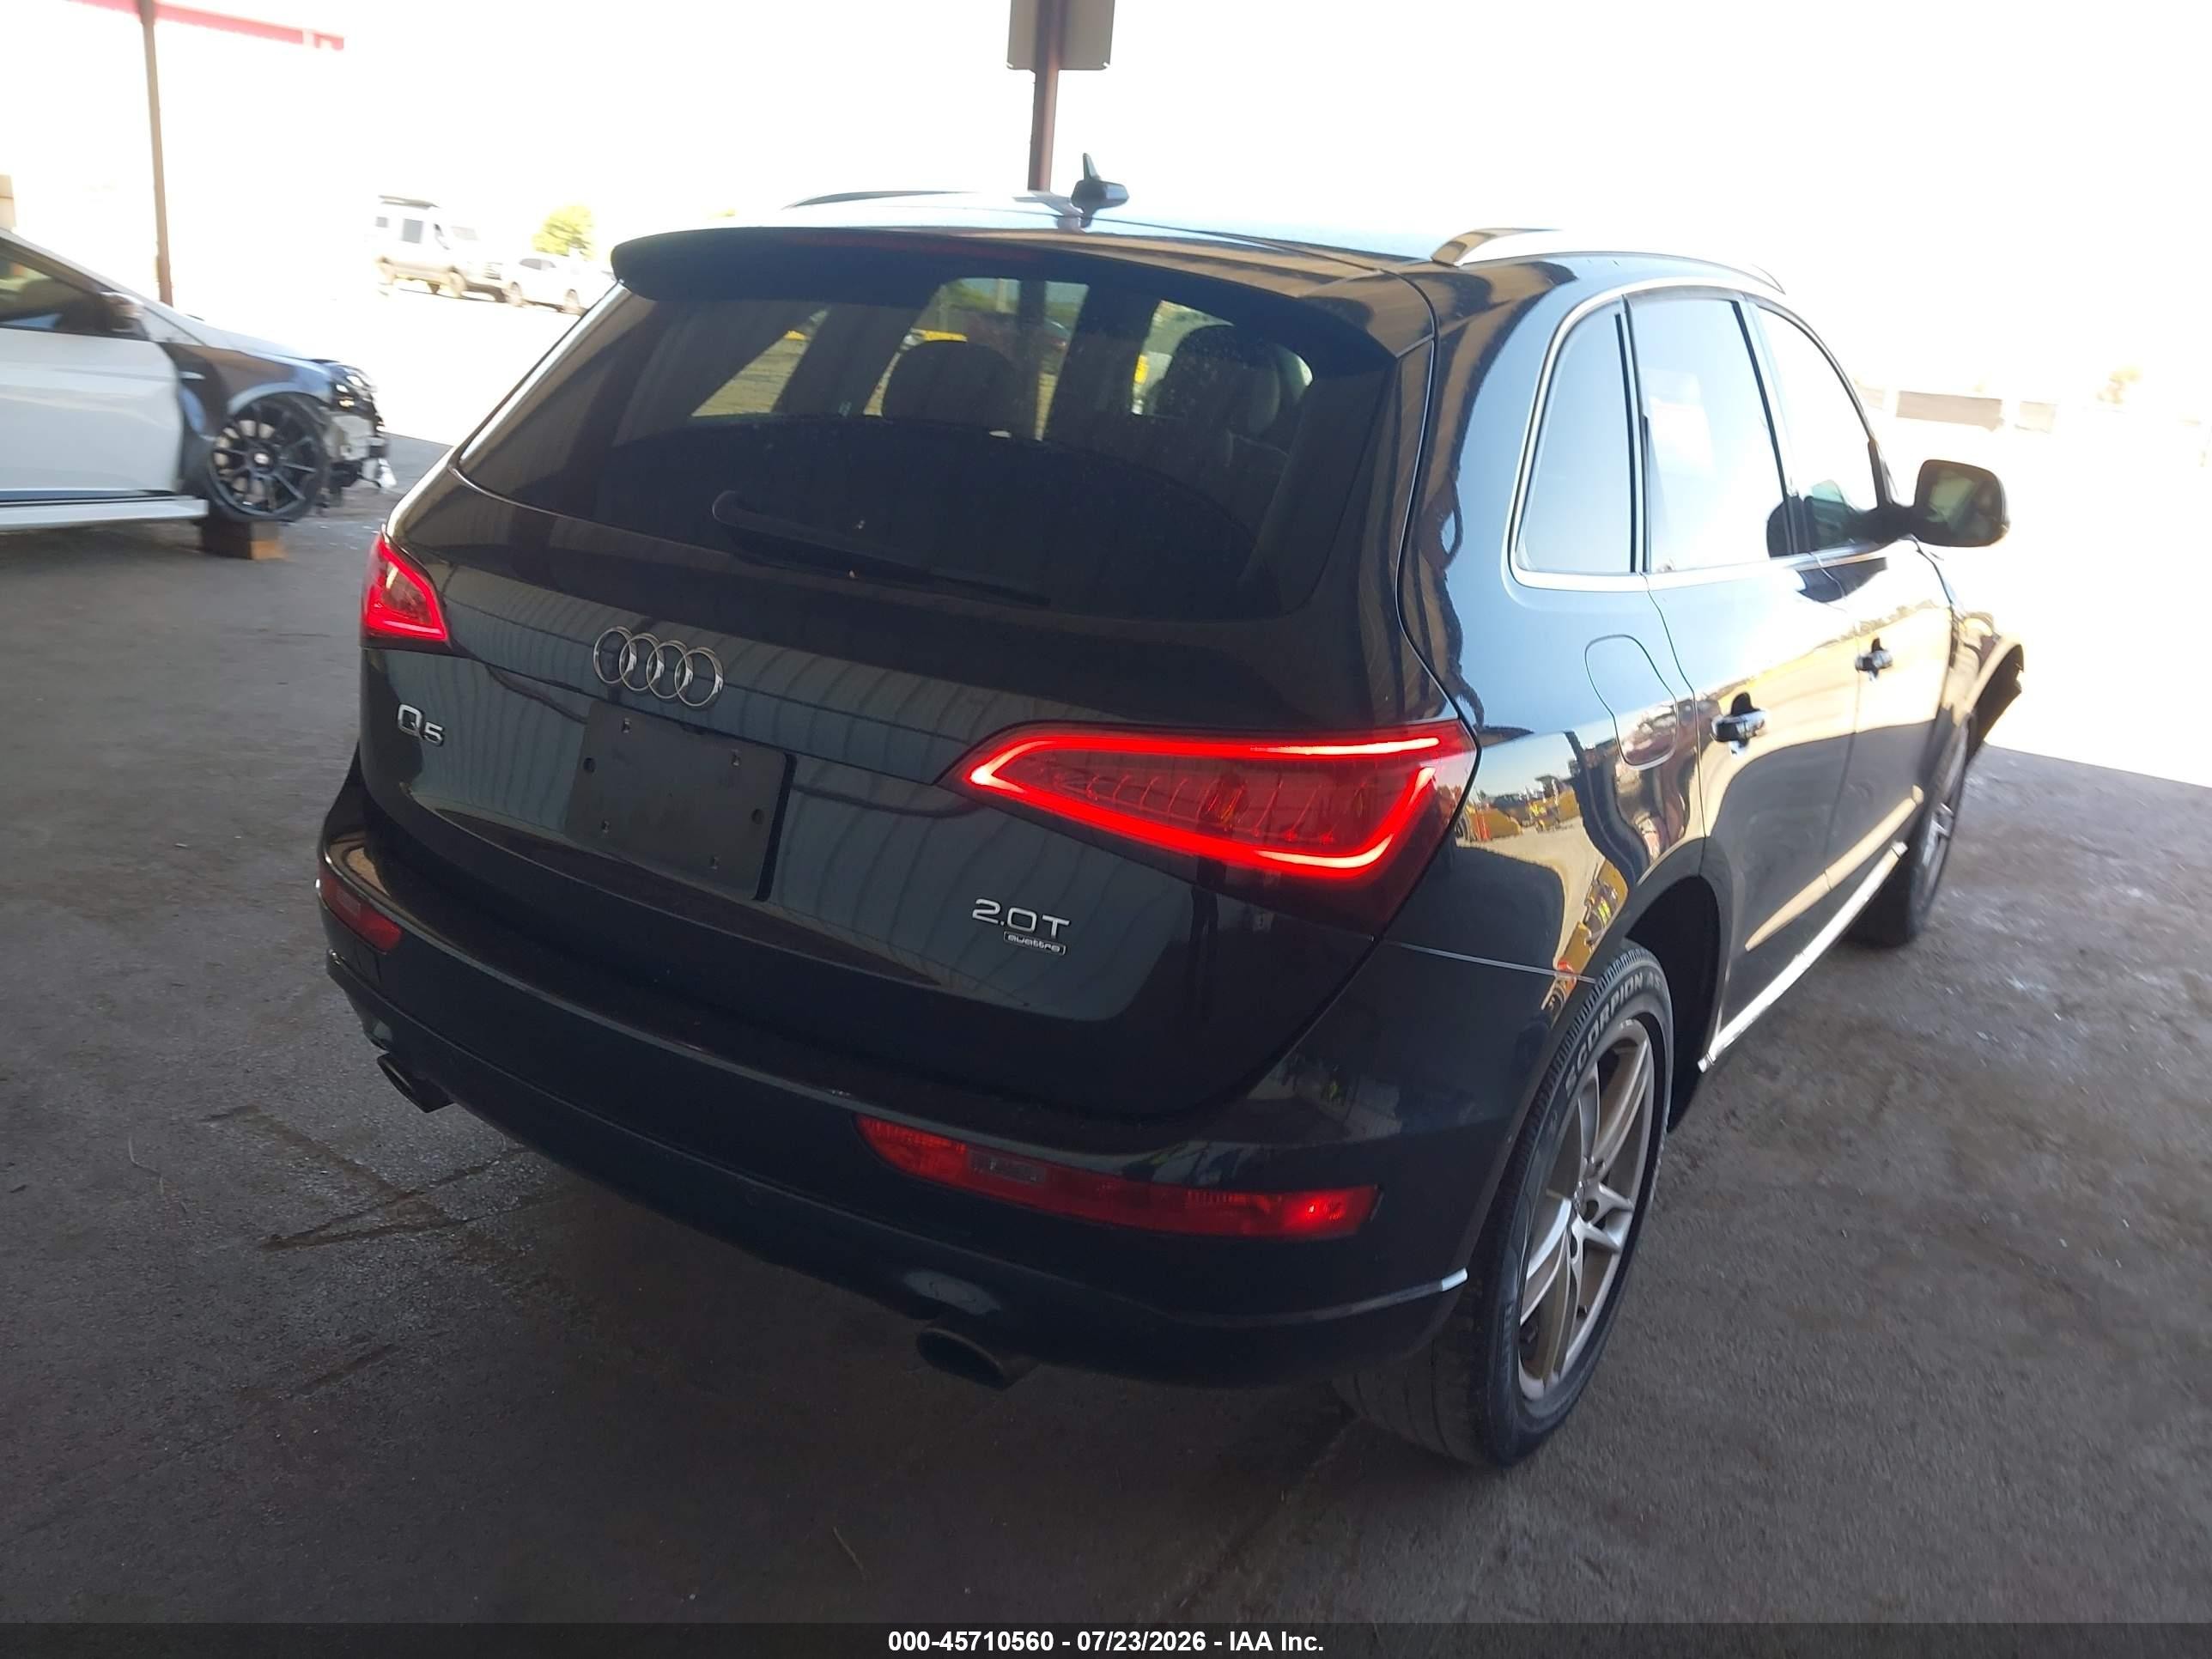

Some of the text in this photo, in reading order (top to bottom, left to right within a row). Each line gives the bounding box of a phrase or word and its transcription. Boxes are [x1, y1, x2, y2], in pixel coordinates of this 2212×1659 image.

[398, 703, 443, 744] Q5
[971, 898, 1071, 939] 2.0T
[1006, 933, 1061, 953] quattro
[1565, 971, 1644, 1099] SCORPION
